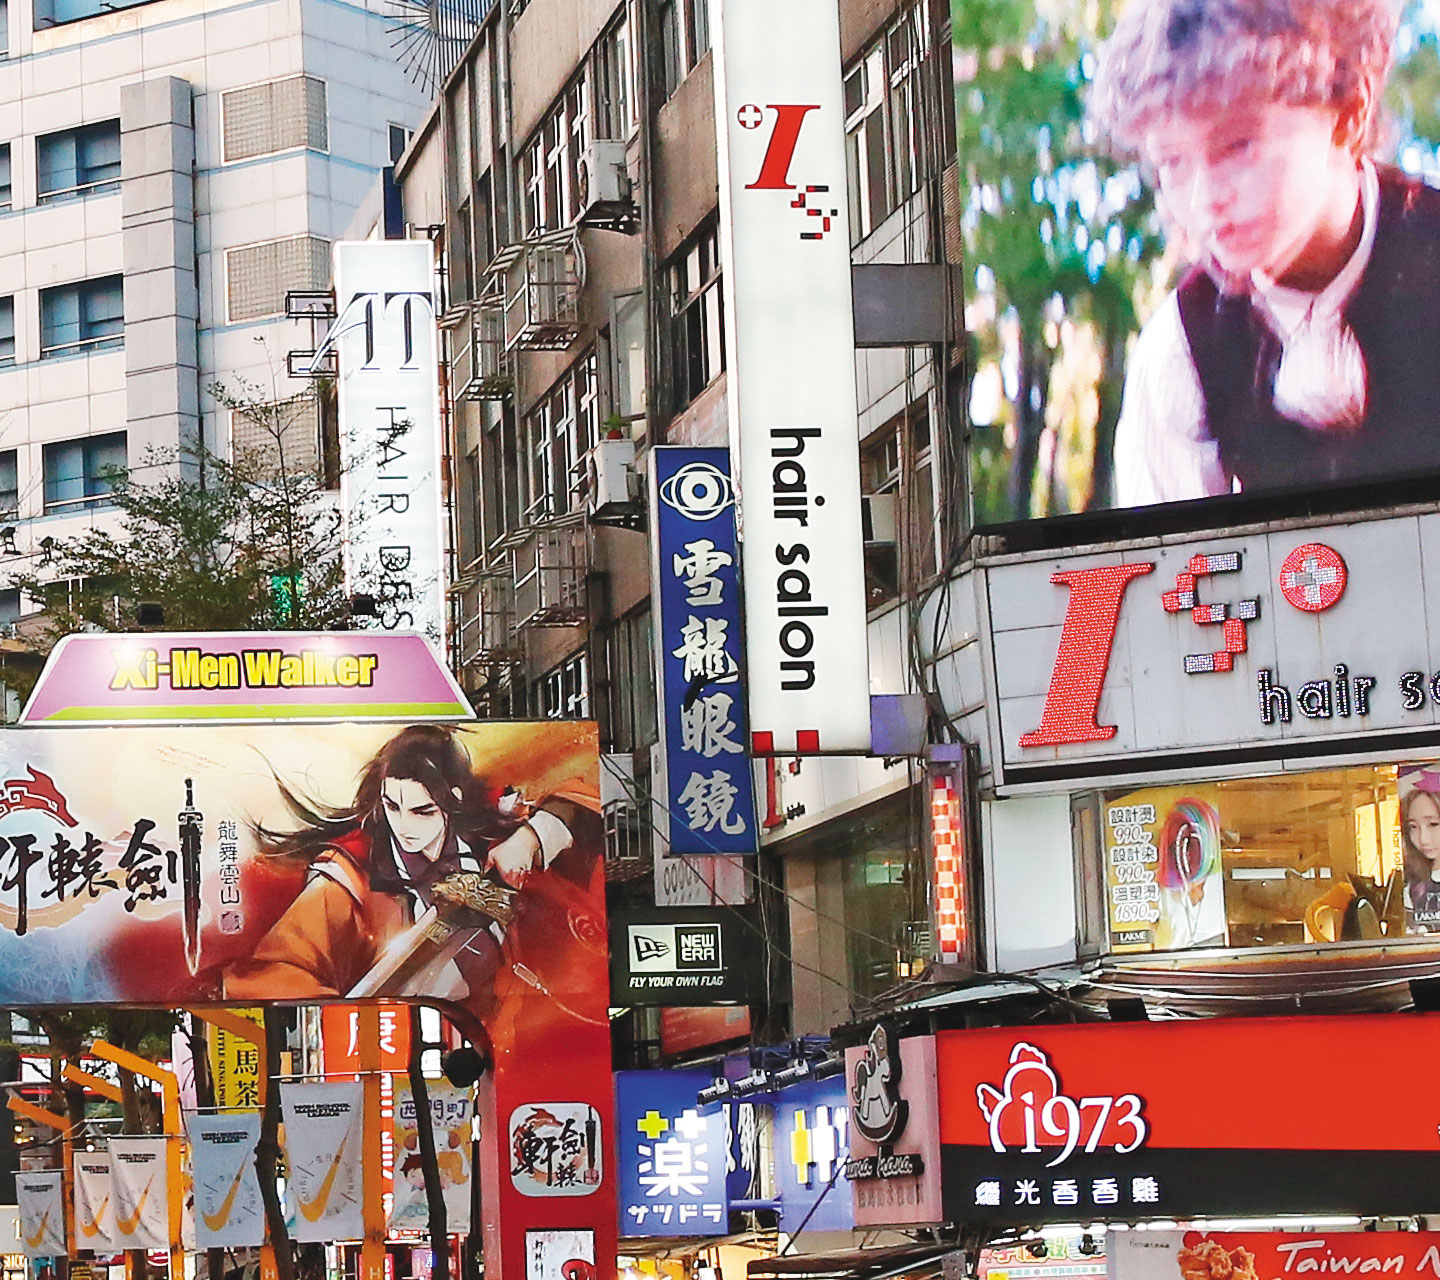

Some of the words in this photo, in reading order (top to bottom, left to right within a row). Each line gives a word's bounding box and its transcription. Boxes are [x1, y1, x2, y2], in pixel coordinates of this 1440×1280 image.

[375, 406, 410, 515] HAIR
[770, 427, 826, 526] hair
[776, 543, 829, 692] salon
[110, 648, 239, 689] Xi-Men
[243, 650, 378, 689] Walker
[673, 539, 747, 839] 雪龍眼鏡
[1256, 663, 1378, 724] hair
[680, 934, 715, 948] NEW
[681, 948, 715, 962] ERA
[629, 976, 647, 988] FLY
[648, 976, 674, 987] YOUR
[675, 976, 699, 987] OWN
[700, 975, 724, 986] FLAG
[1020, 1091, 1148, 1168] 1973
[974, 1176, 1159, 1206] 繼光香香雞
[627, 1204, 722, 1225] サツドラ
[1276, 1239, 1405, 1274] Taiwan
